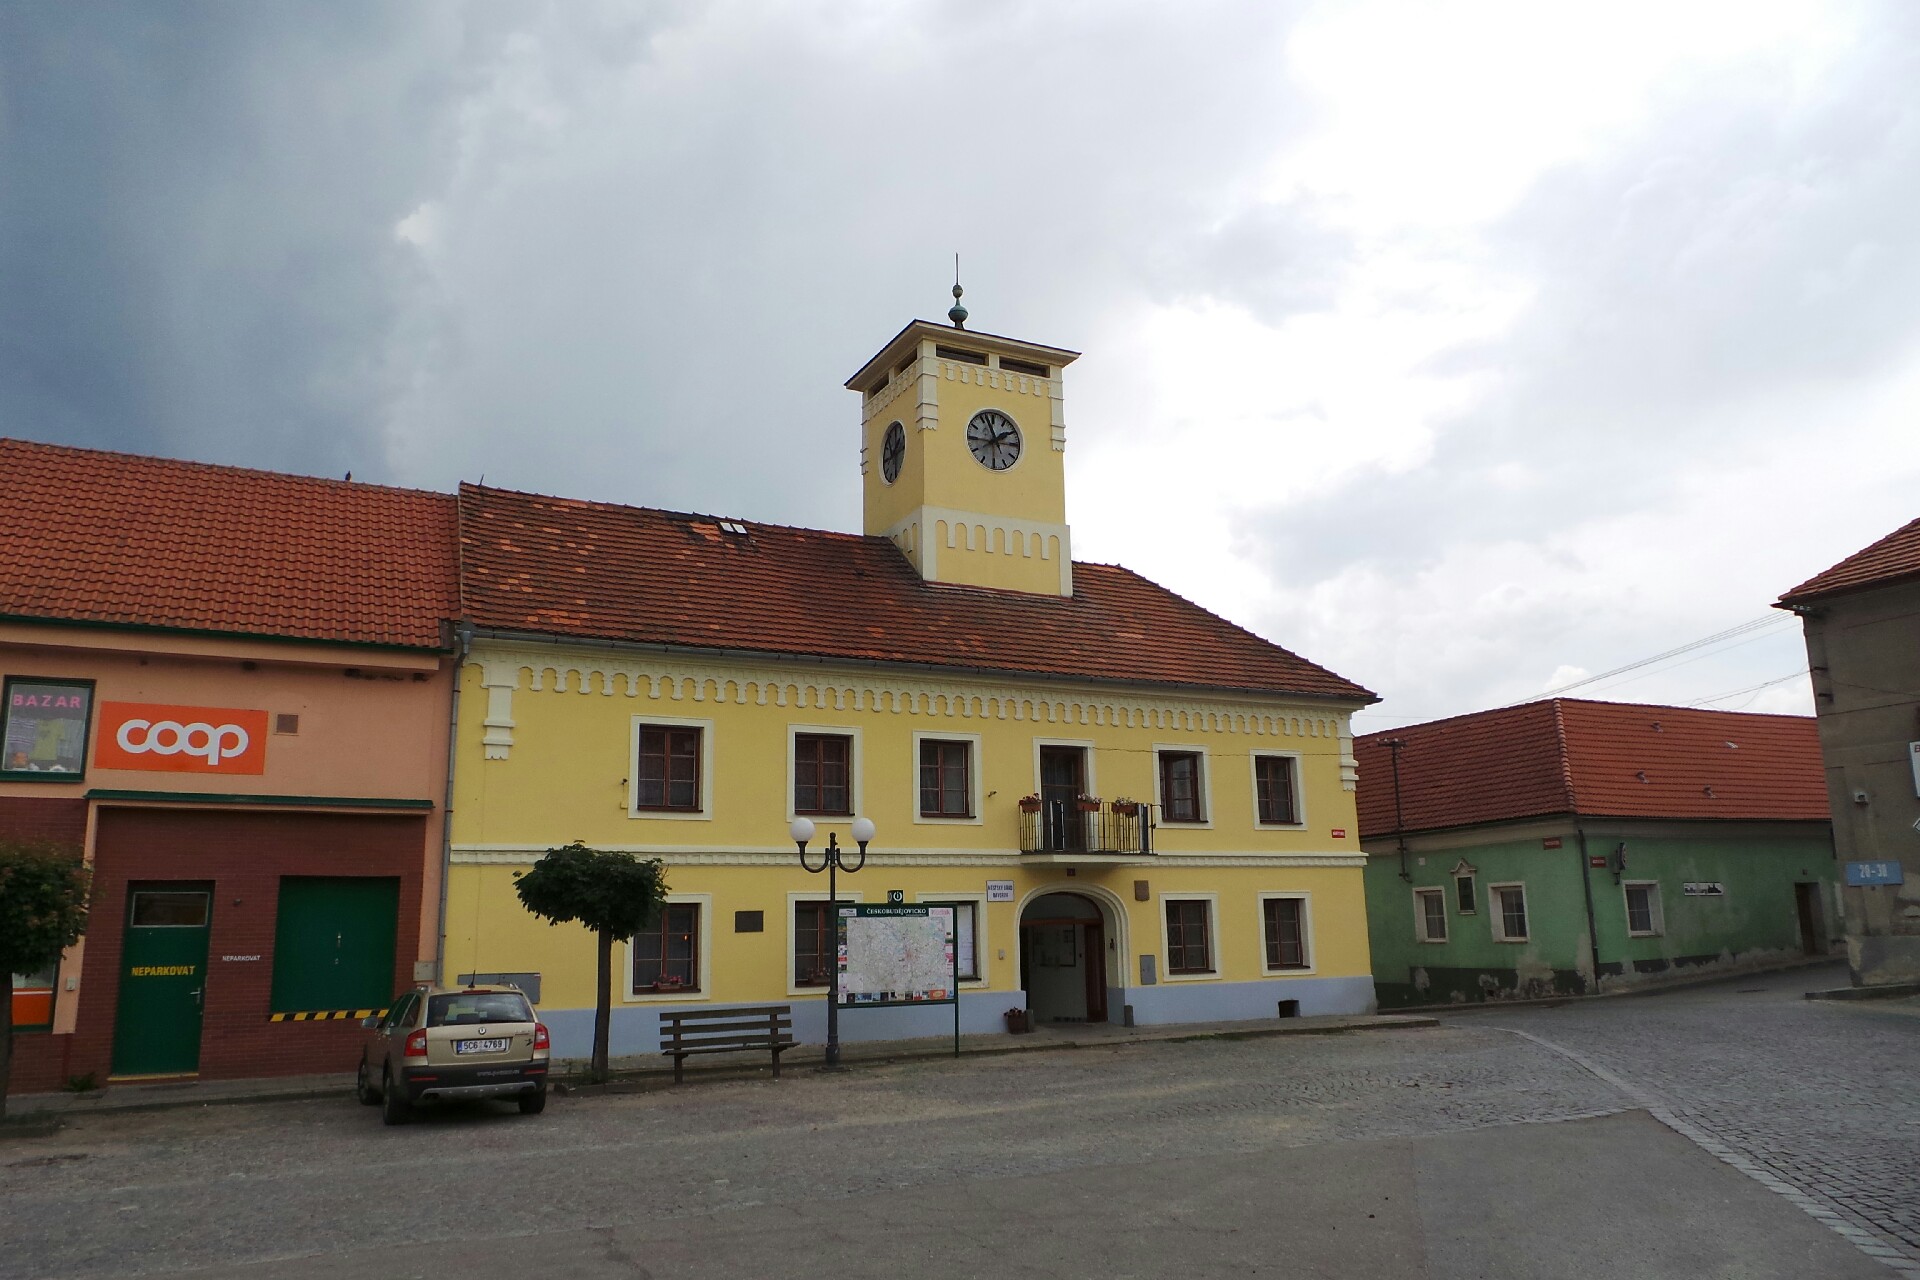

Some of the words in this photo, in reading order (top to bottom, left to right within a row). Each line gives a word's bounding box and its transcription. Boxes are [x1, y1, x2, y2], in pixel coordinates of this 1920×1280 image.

[13, 694, 81, 708] BAZAR
[116, 719, 249, 766] coop
[131, 966, 196, 977] NEPARKOVAT
